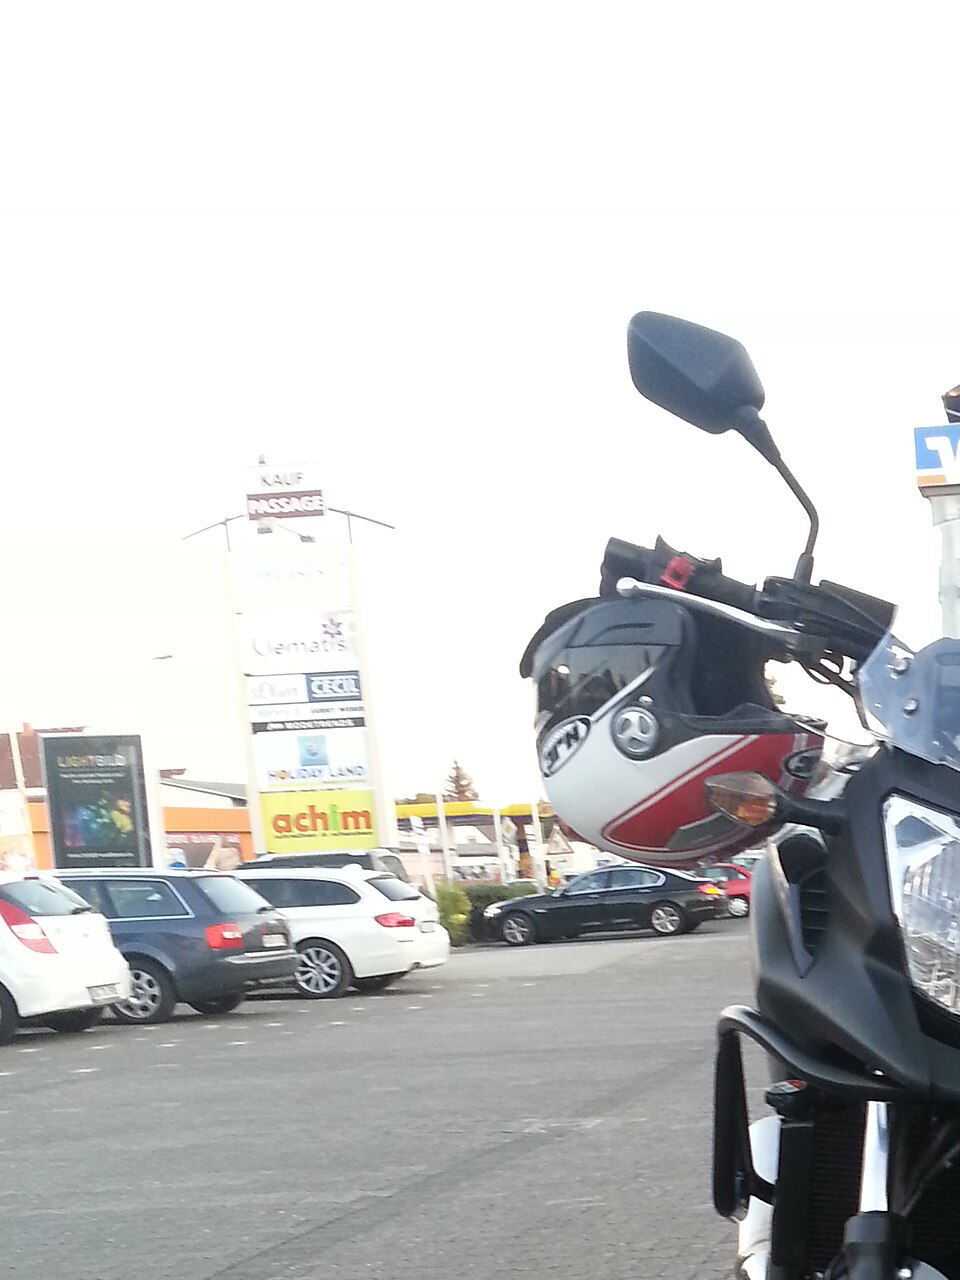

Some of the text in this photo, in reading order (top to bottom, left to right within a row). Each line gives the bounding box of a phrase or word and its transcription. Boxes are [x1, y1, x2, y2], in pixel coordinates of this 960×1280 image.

[260, 472, 304, 487] KAUF
[249, 495, 325, 514] PASSAGE
[311, 678, 360, 694] CECIL
[267, 765, 366, 781] HOLIDAY LAND
[272, 804, 372, 833] achim
